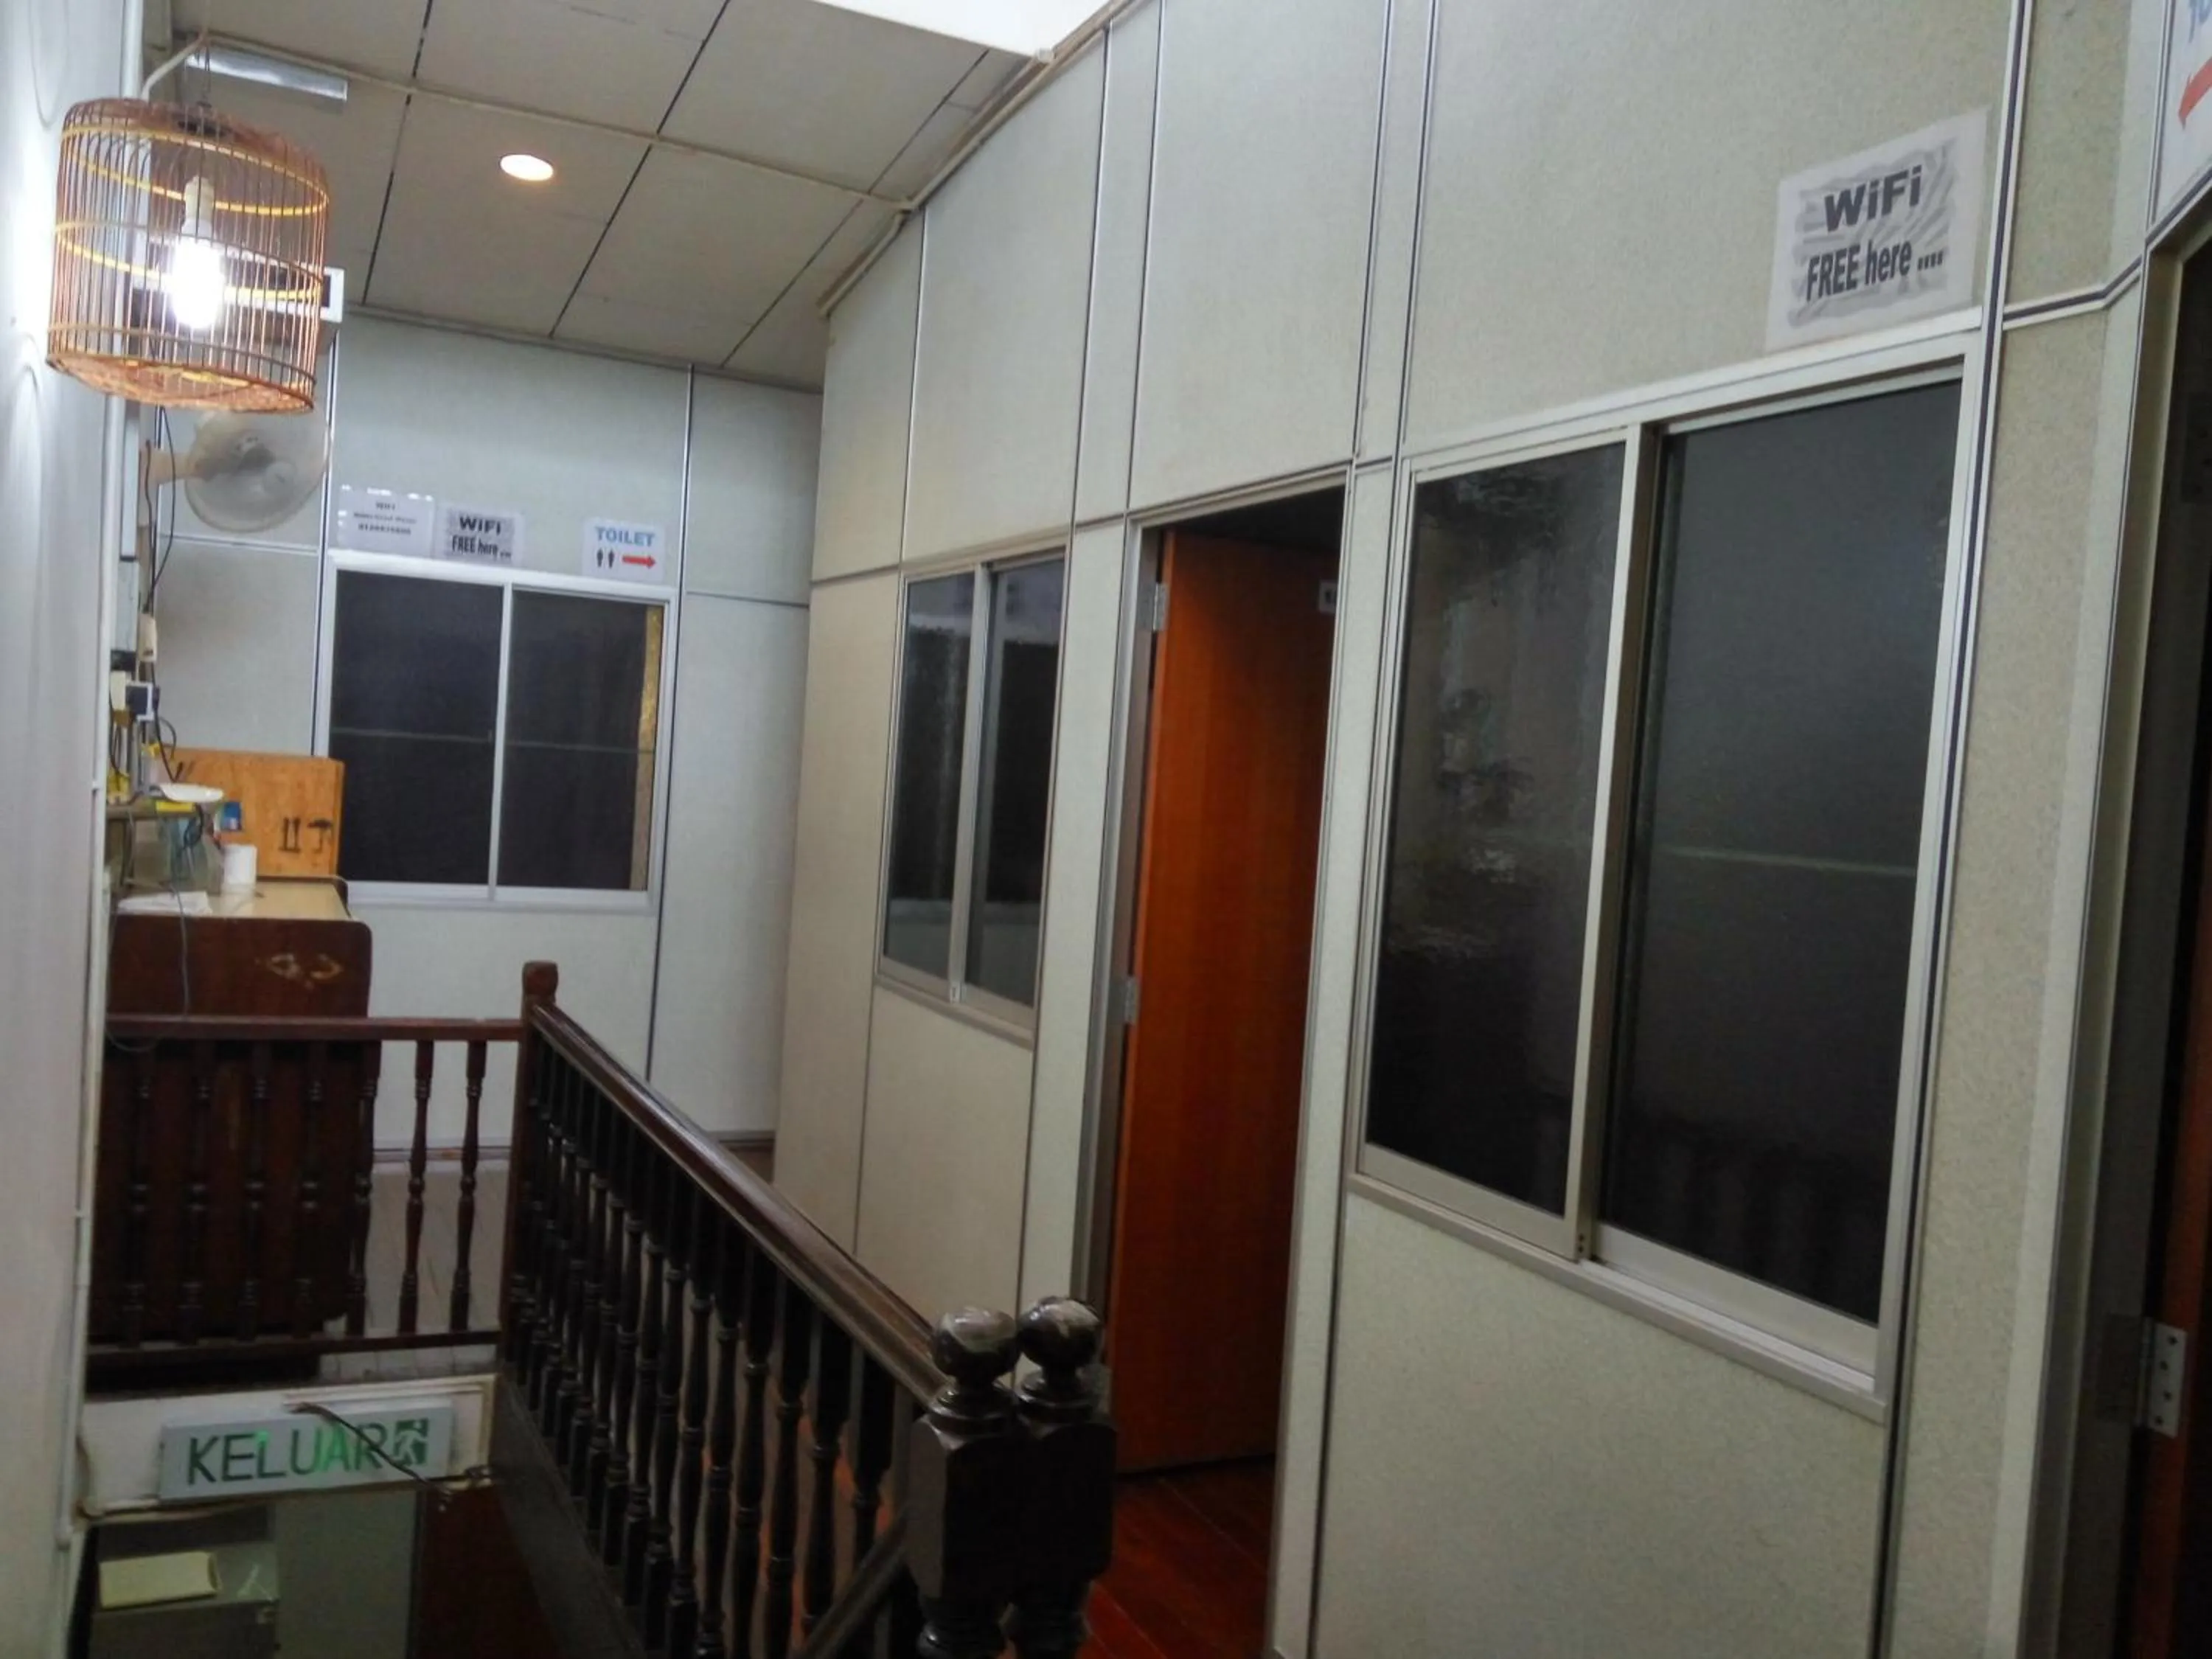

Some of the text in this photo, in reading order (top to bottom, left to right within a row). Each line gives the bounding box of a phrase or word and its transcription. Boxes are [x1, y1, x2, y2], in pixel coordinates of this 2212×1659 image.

[1823, 164, 1922, 233] WiFi
[1805, 244, 1861, 302] FREE
[452, 535, 476, 554] FREE
[594, 525, 655, 548] TOILET
[186, 1421, 388, 1486] KELUAR
